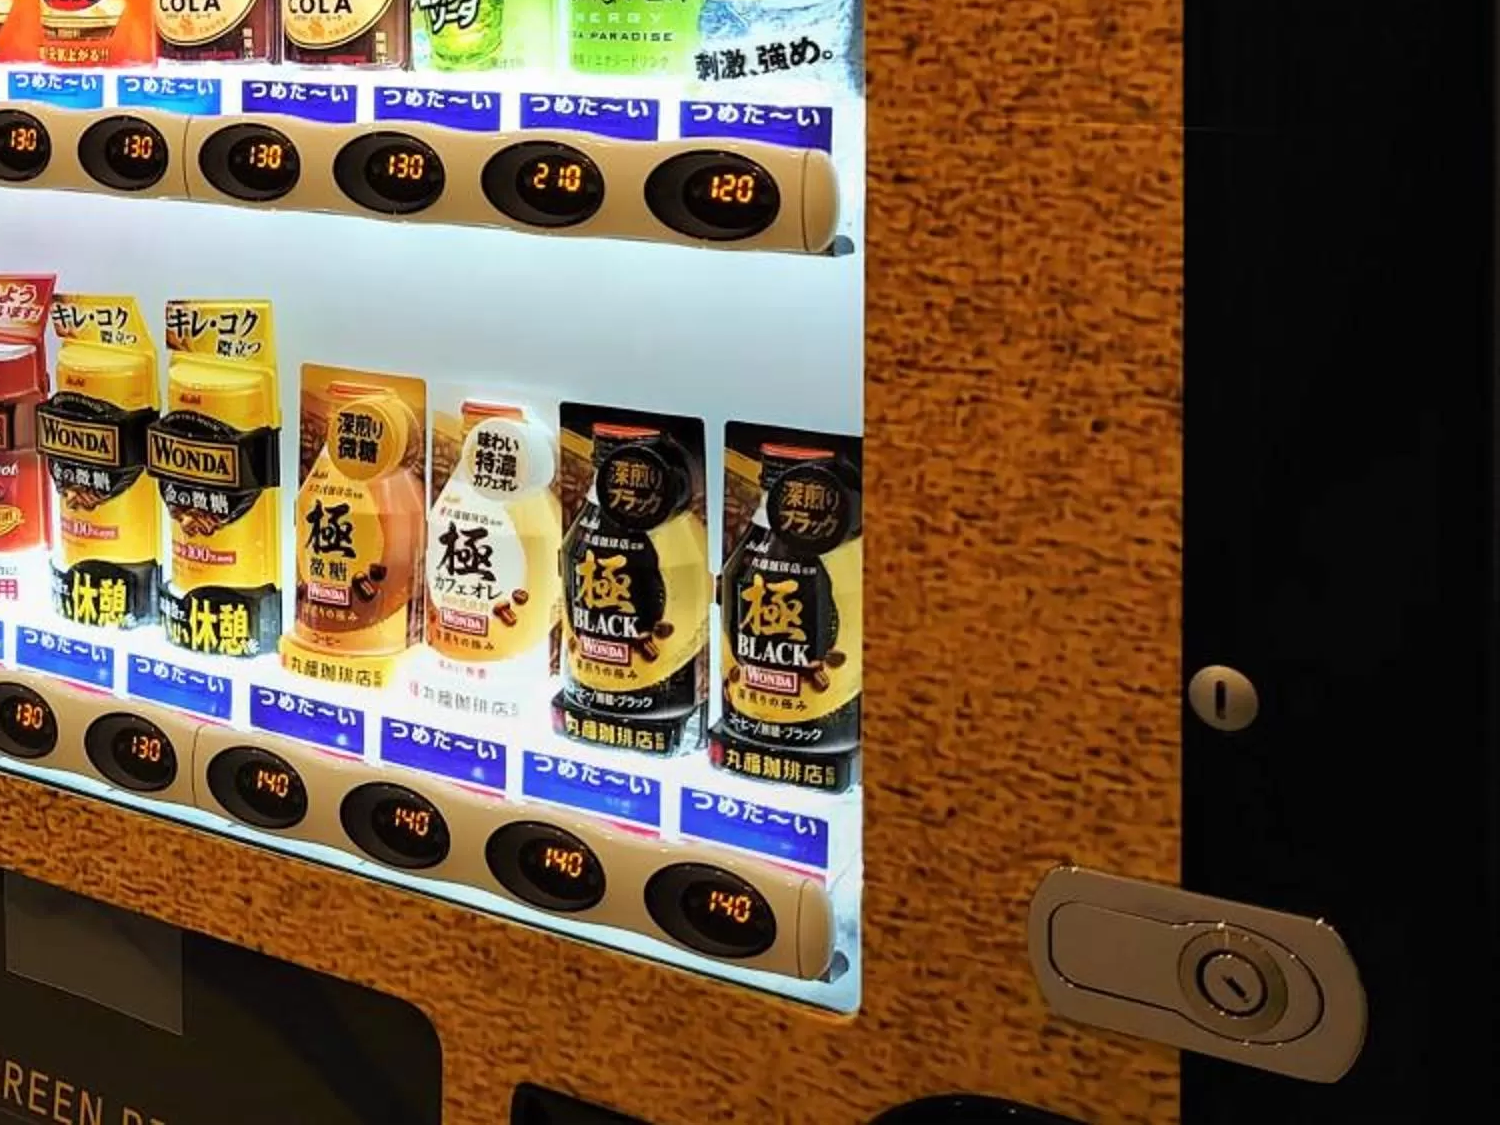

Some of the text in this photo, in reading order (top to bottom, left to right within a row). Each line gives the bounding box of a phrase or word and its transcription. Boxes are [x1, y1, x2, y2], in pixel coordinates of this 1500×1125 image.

[695, 36, 835, 82] 刺激、強め。
[10, 128, 37, 151] 130
[124, 135, 152, 158] 130
[250, 144, 281, 169] 130
[387, 154, 425, 180] 130
[533, 164, 582, 191] 210
[709, 174, 754, 203] 120
[40, 415, 111, 456] WONDA
[152, 434, 231, 478] WONDA
[573, 608, 639, 639] BLACK
[737, 632, 810, 668] BLACK
[15, 702, 44, 730] 130
[131, 735, 161, 763] 130
[256, 769, 289, 797] 140
[394, 806, 430, 837] 140
[544, 845, 584, 878] 140
[709, 887, 752, 924] 140
